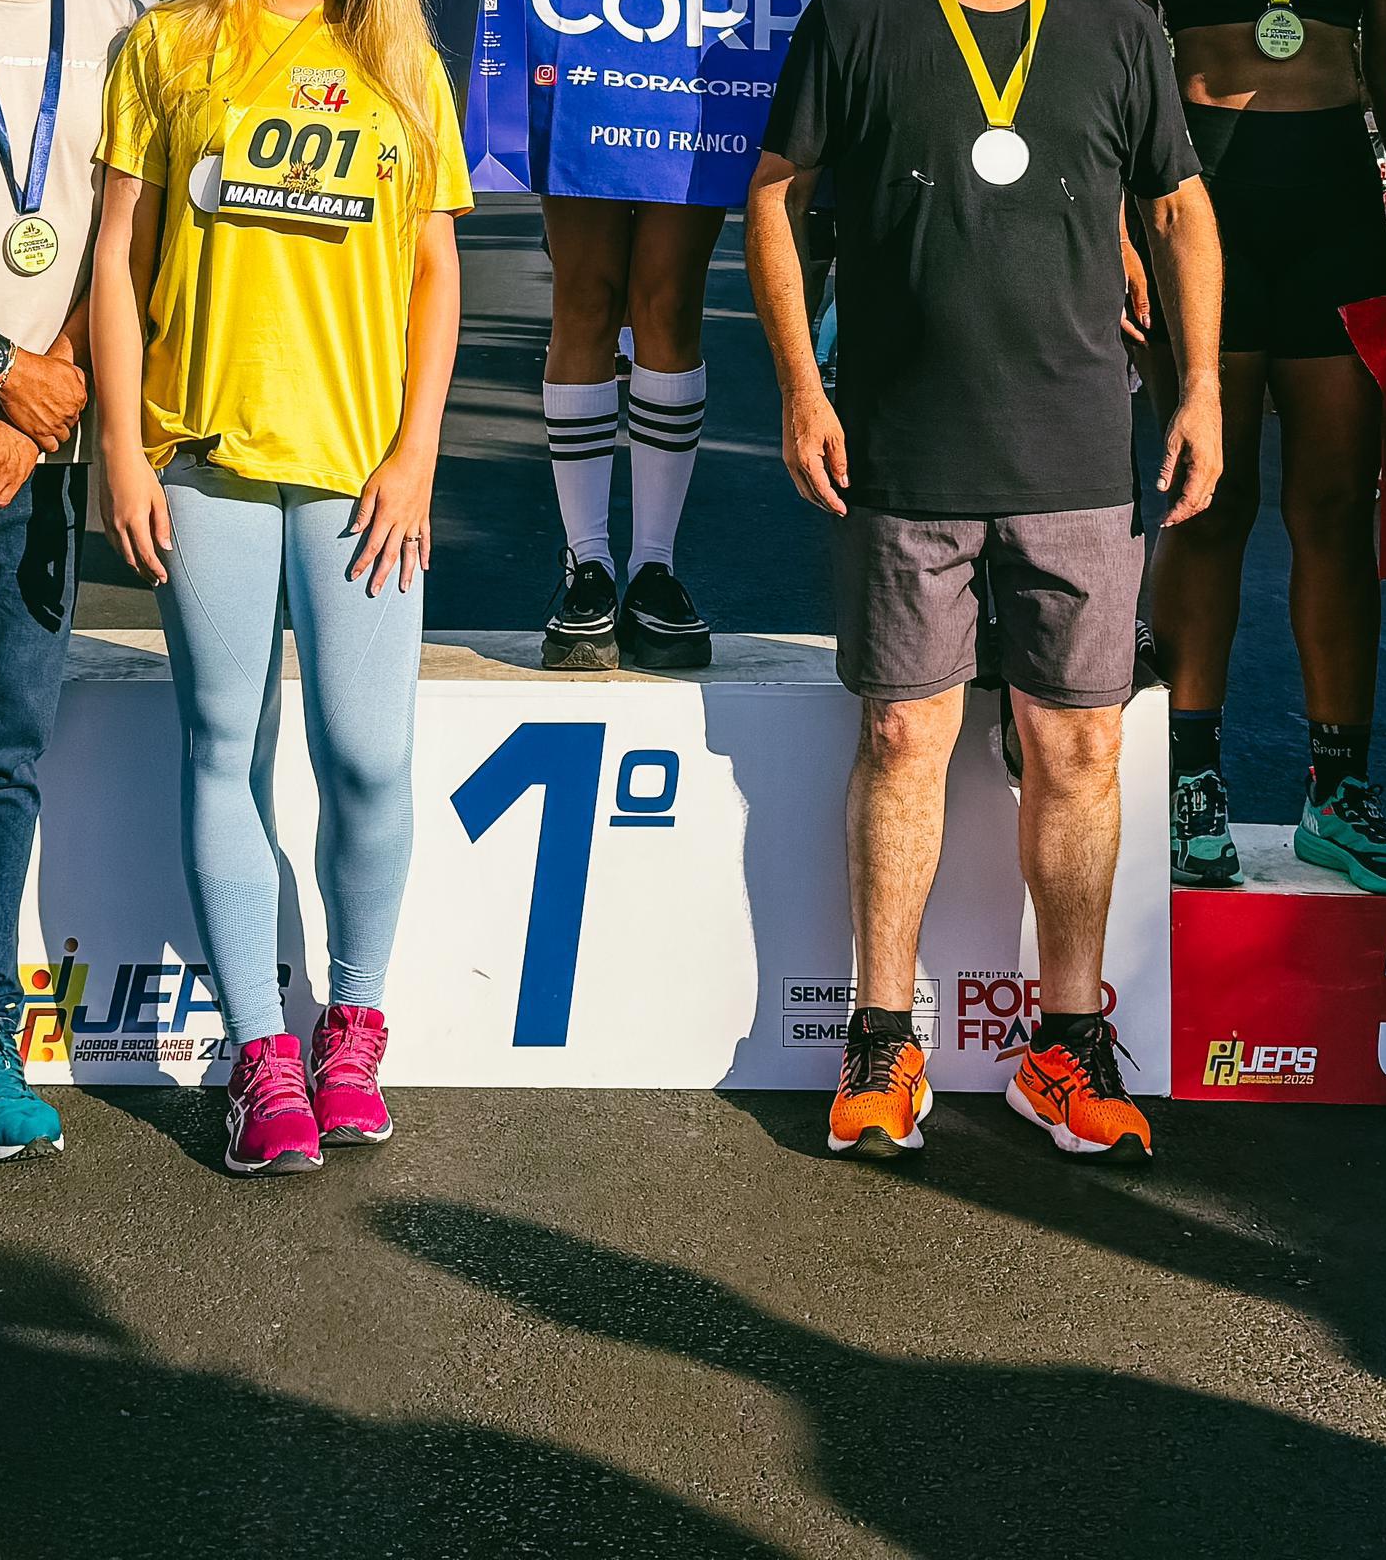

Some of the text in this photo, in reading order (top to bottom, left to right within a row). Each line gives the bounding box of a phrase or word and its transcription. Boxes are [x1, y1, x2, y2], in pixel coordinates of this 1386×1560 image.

[247, 117, 361, 179] 001
[590, 124, 661, 149] PORTO
[668, 130, 748, 154] FRANCO
[225, 185, 283, 209] MARIA
[286, 192, 344, 215] CLARA
[344, 198, 367, 218] M.
[450, 722, 680, 1048] 1º
[957, 971, 1024, 979] PREFEITURA
[71, 963, 293, 1033] JEP
[73, 1051, 192, 1062] PORTOFRANQUINOS
[122, 1039, 194, 1050] ESCOLARES
[1238, 1046, 1317, 1073] JEPS
[1284, 1074, 1314, 1085] 2025
